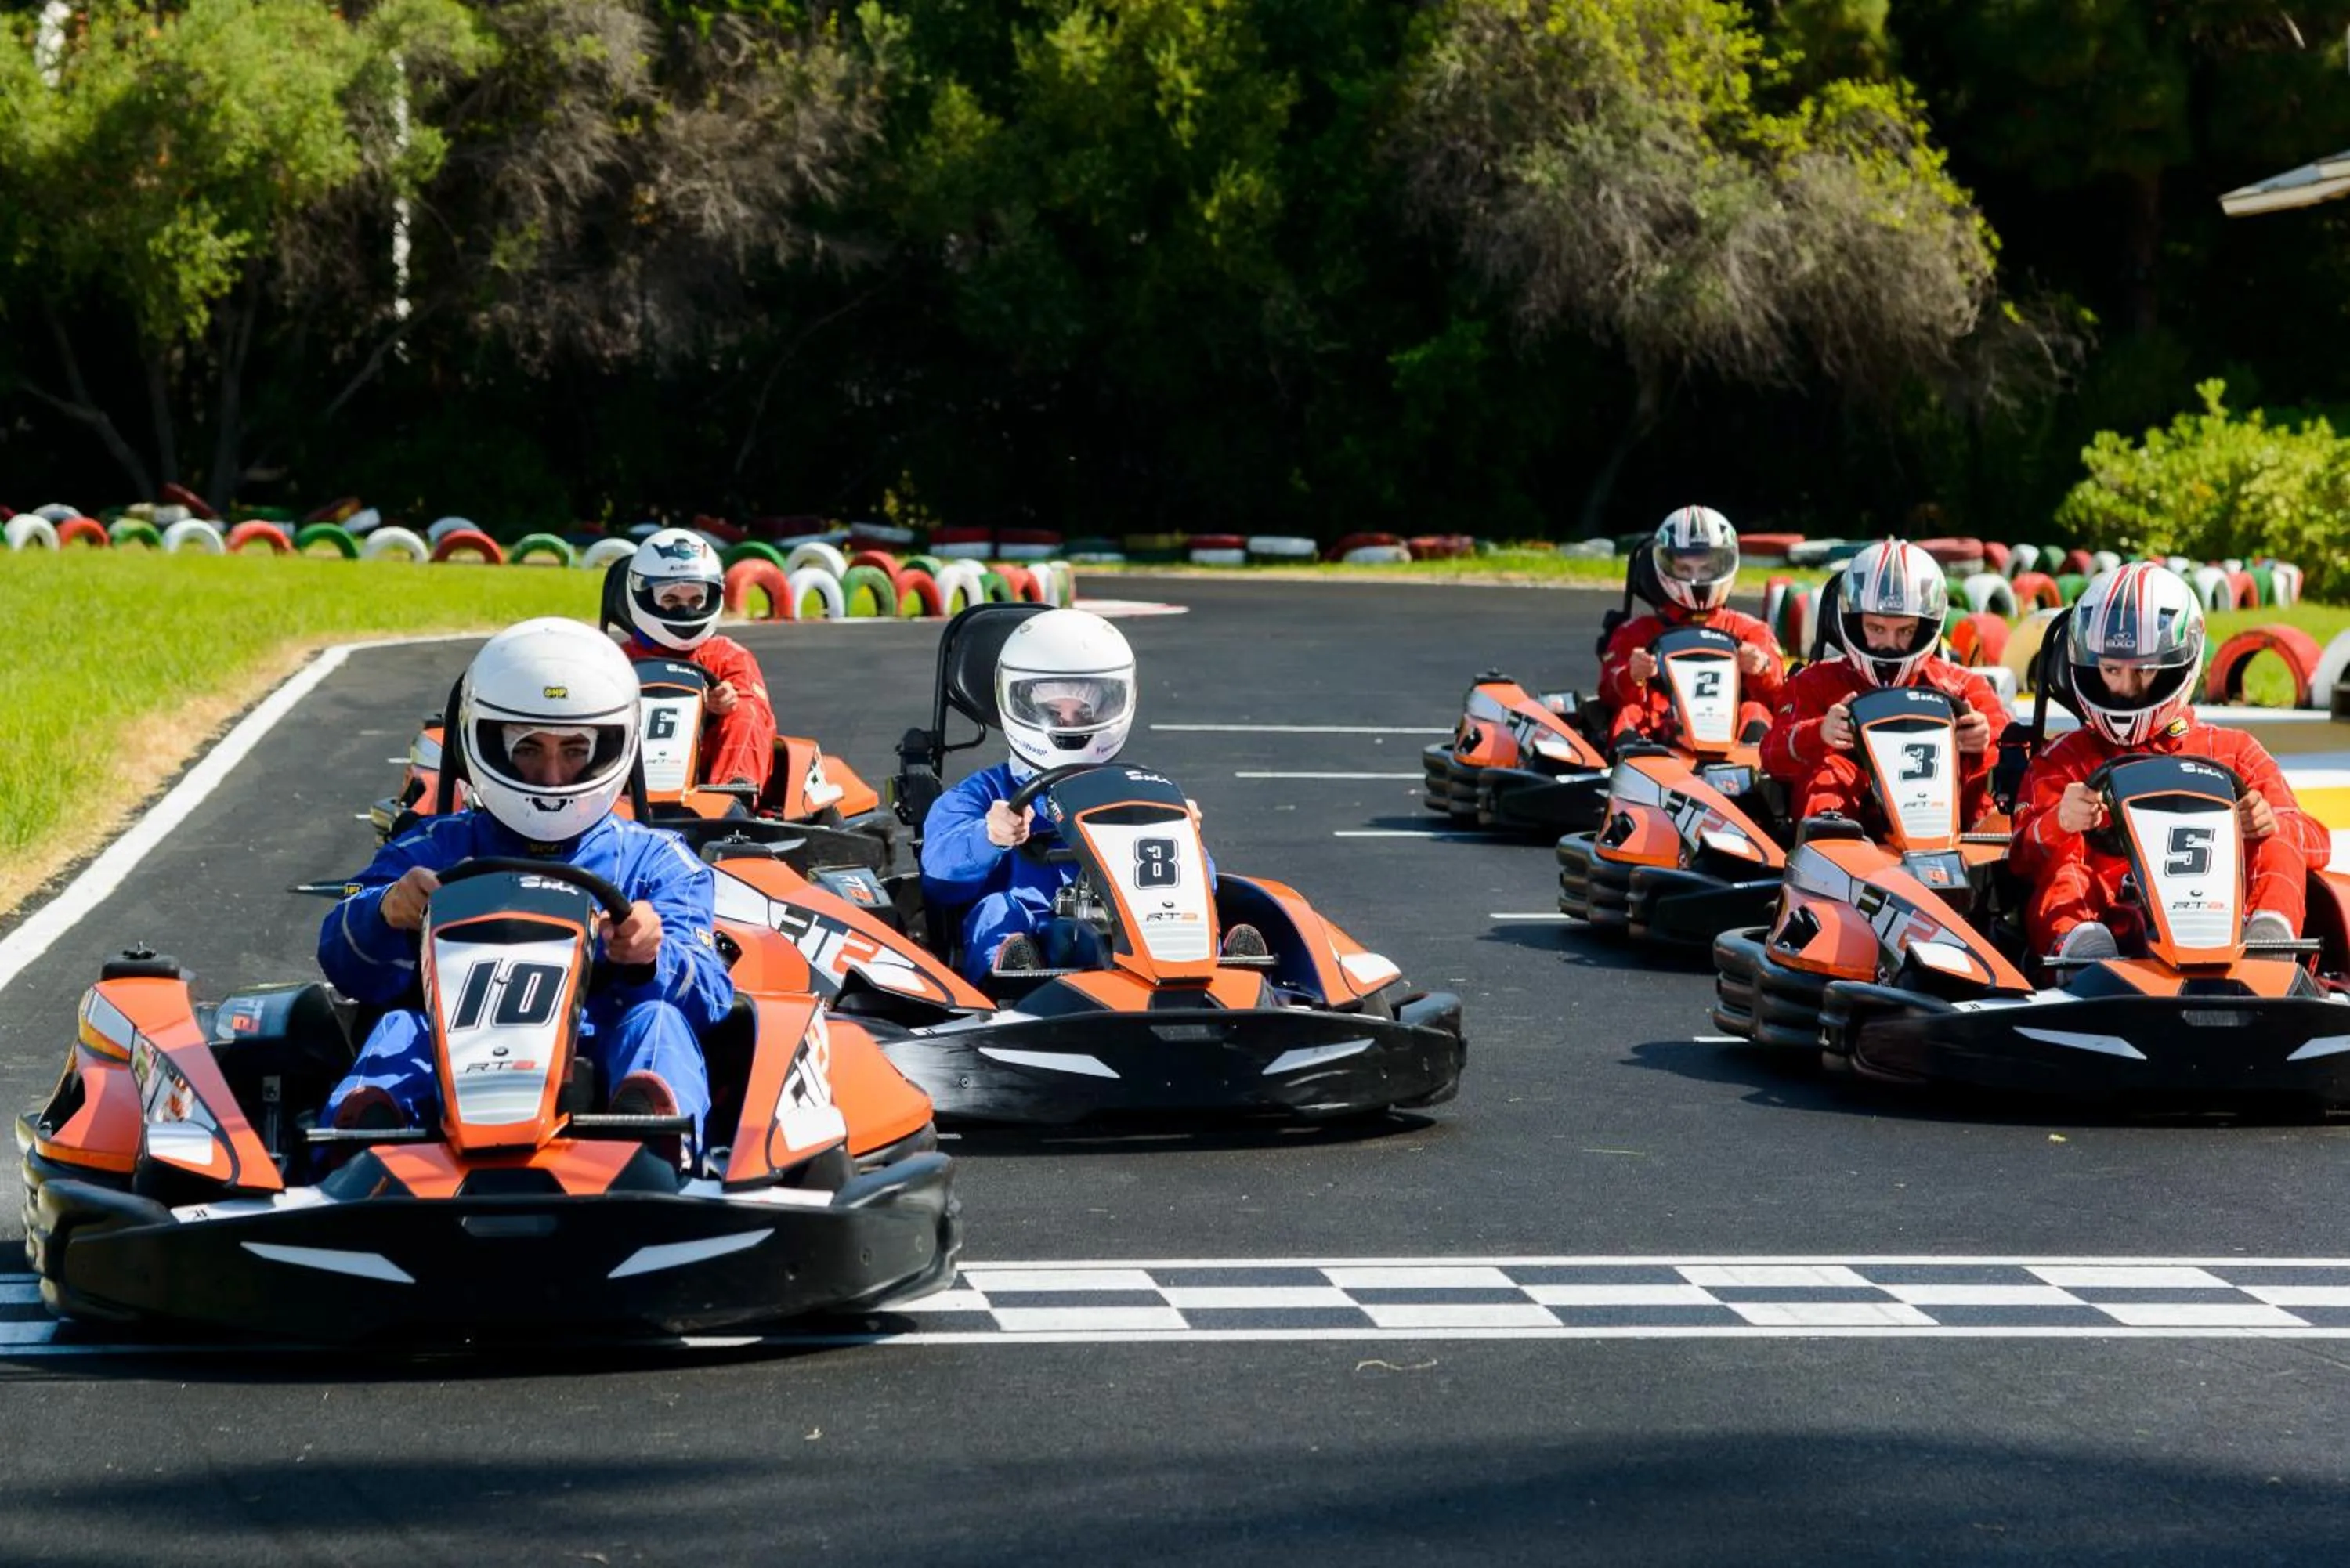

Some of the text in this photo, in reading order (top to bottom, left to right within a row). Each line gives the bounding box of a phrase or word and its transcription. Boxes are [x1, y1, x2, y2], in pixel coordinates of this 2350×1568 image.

[1694, 671, 1722, 699] 2
[645, 706, 679, 741] 6
[1900, 743, 1939, 780] 3
[1134, 836, 1180, 890] 8
[2164, 826, 2215, 877] 5
[449, 959, 569, 1031] 10
